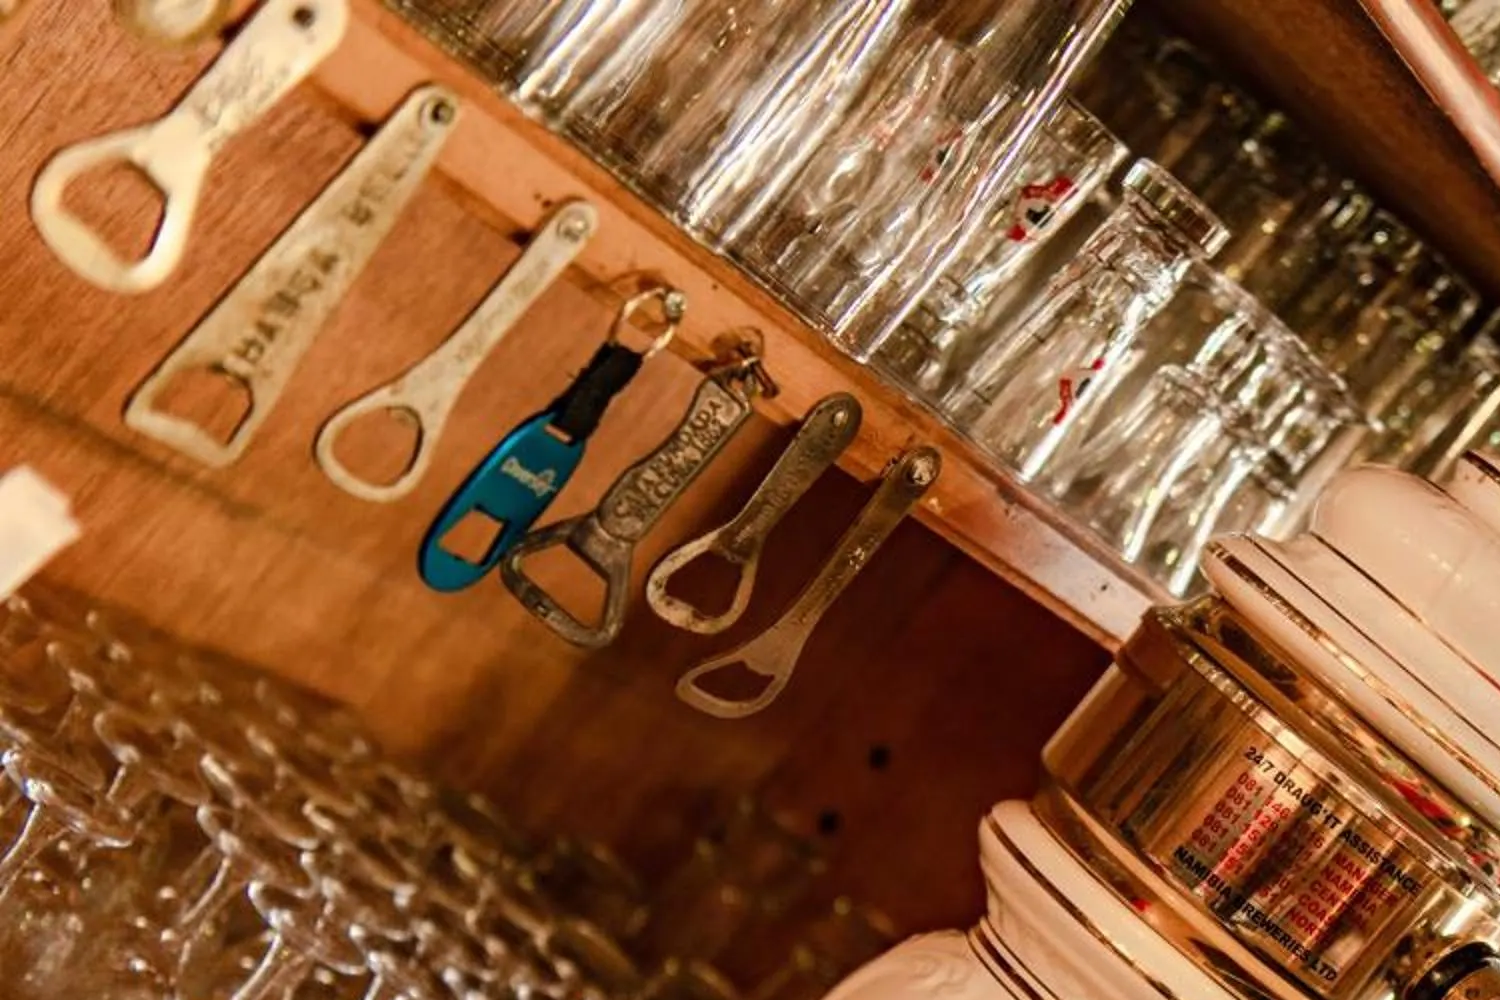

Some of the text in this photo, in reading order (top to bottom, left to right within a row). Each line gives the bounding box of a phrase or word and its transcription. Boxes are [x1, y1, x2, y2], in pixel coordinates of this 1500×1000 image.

[1237, 772, 1263, 796] 081
[1225, 786, 1251, 810] 081
[1214, 800, 1239, 824] 081
[1244, 746, 1275, 774] 24/7
[1272, 772, 1341, 830] DRAUGHT
[1340, 827, 1422, 896] ASSISTANCE
[1202, 814, 1228, 838] 081
[1173, 846, 1233, 898] NAMIBIA
[1236, 895, 1311, 961] BREWERIES
[1311, 957, 1337, 982] LTD
